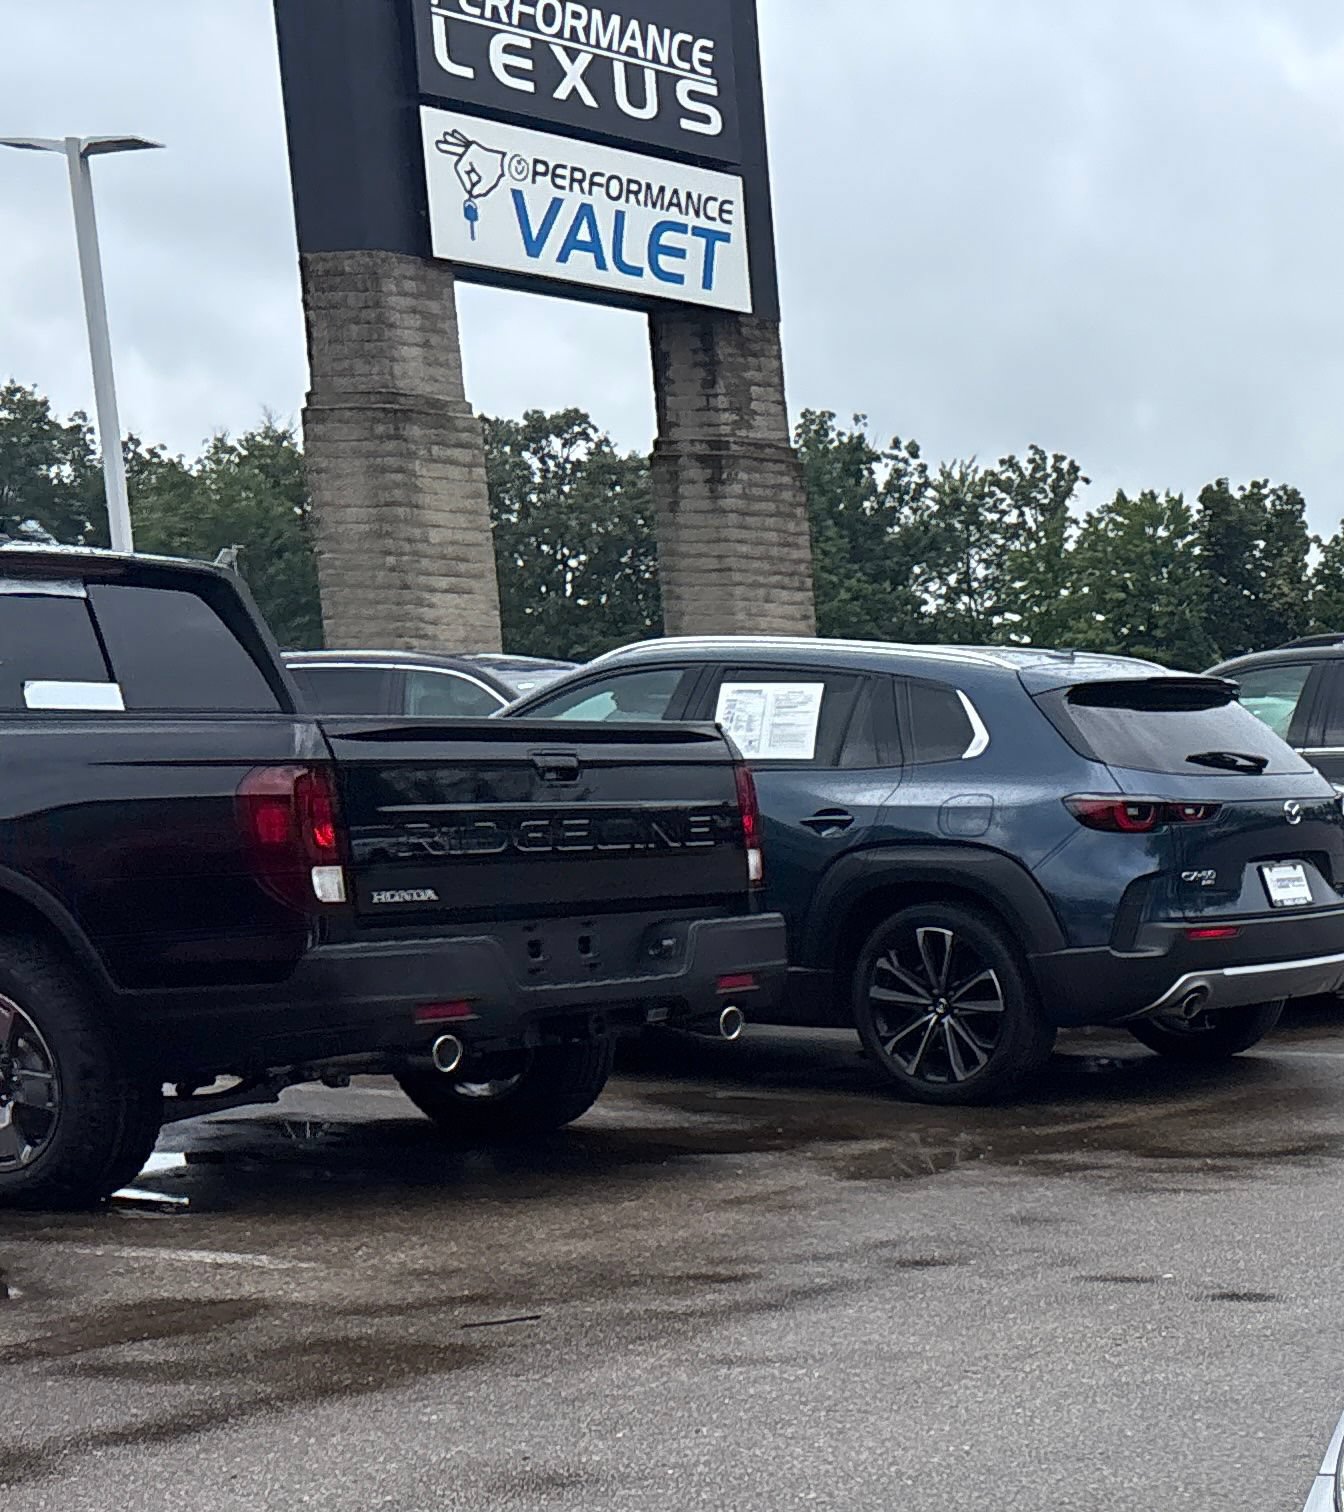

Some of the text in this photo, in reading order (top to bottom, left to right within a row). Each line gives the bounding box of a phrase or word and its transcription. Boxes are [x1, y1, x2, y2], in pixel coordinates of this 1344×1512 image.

[431, 13, 723, 136] LEXUS
[531, 157, 734, 225] PERFORMANCE
[510, 187, 732, 291] VALET
[371, 889, 440, 904] HONDA
